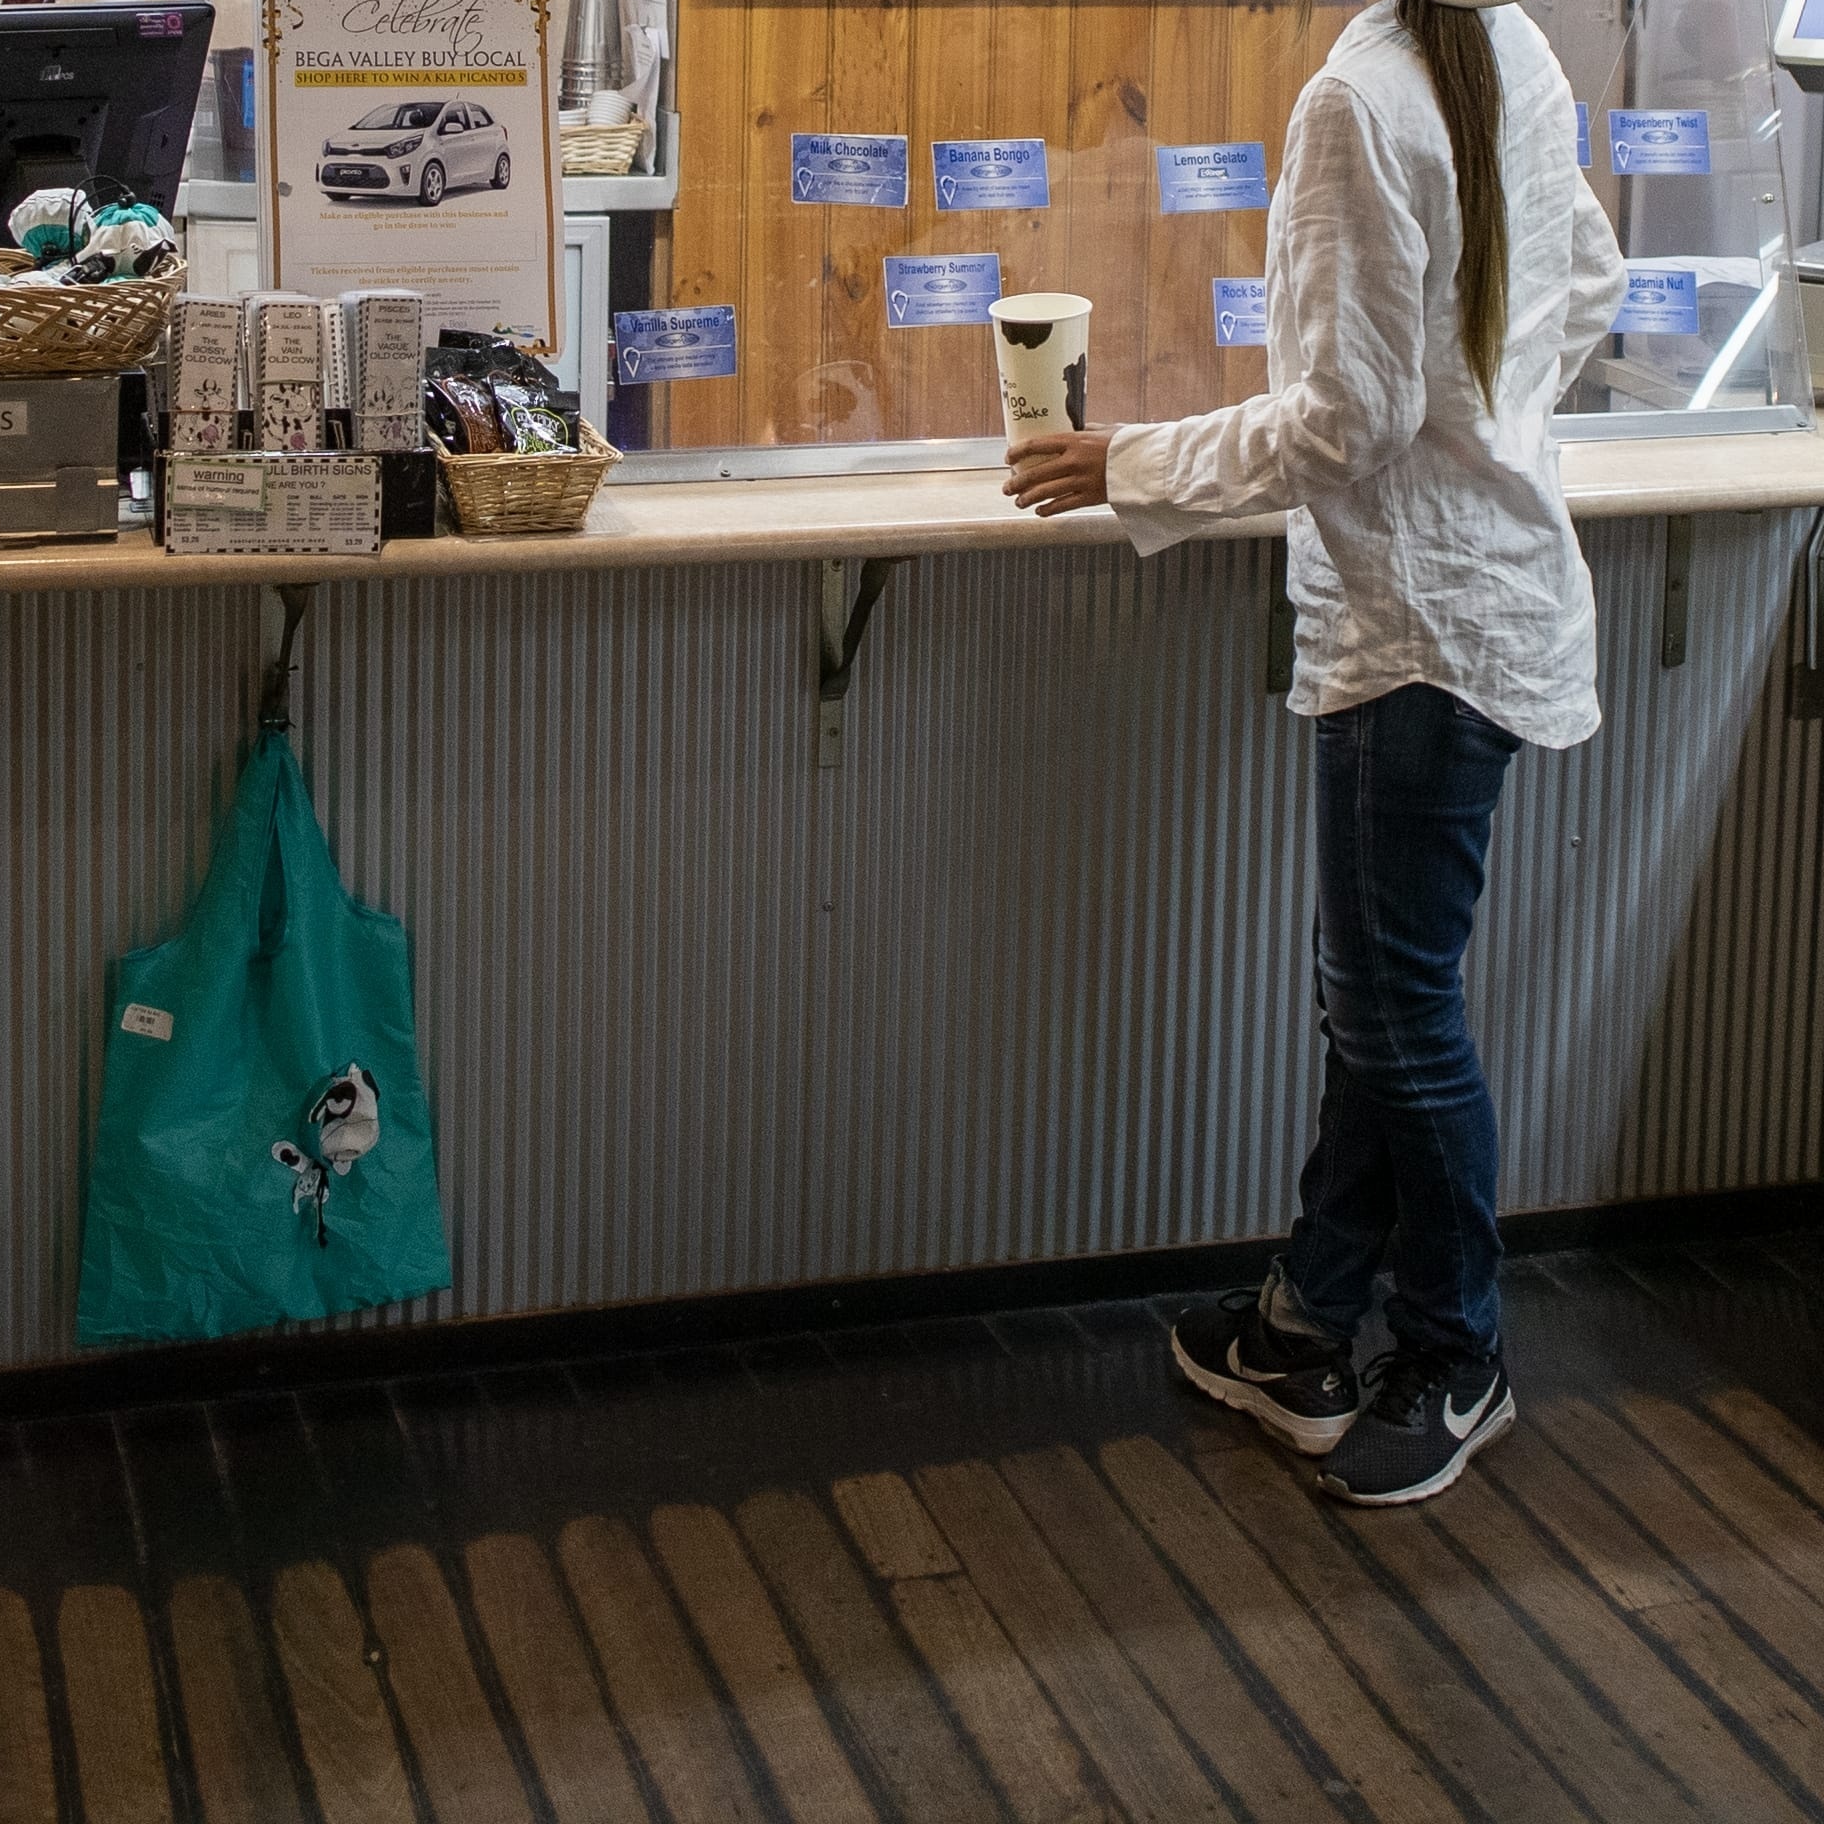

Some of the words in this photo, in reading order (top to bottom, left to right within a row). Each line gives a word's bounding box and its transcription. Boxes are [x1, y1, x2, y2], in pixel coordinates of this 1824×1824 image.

[295, 51, 344, 67] BEGA
[348, 51, 416, 67] VALLEY
[421, 51, 458, 67] BUY
[464, 51, 527, 67] LOCAL
[296, 71, 332, 84] SHOP
[335, 71, 368, 84] HERE
[371, 71, 388, 83] TO
[391, 71, 422, 83] WIN
[423, 71, 433, 83] A
[434, 71, 457, 83] KIA
[459, 70, 516, 83] PICANTO
[1619, 115, 1675, 130] Boysenberry
[1676, 115, 1699, 129] Twist
[809, 140, 833, 156] Milk
[835, 141, 890, 159] Chocolate
[949, 148, 992, 163] Banana
[993, 147, 1032, 164] Bongo
[1173, 153, 1211, 167] Lemon
[1212, 152, 1249, 165] Gelato
[897, 261, 947, 276] Strawberry
[1666, 277, 1685, 291] Nut
[1221, 285, 1248, 299] Rock
[199, 309, 226, 319] ARIES
[282, 311, 303, 320] LEO
[377, 305, 411, 315] PISCES
[630, 315, 668, 334] Vanilla
[670, 313, 721, 332] Supreme
[192, 346, 227, 356] BOSSY
[280, 346, 304, 356] VAIN
[376, 342, 410, 353] VAGUE
[184, 354, 208, 365] OLD
[207, 355, 234, 366] COW
[267, 355, 290, 365] OLD
[291, 356, 316, 366] COW
[369, 351, 393, 361] OLD
[393, 351, 417, 361] COW
[1012, 406, 1050, 422] shake
[193, 469, 245, 484] warning
[291, 464, 330, 476] BIRTH
[332, 464, 372, 477] SIGNS
